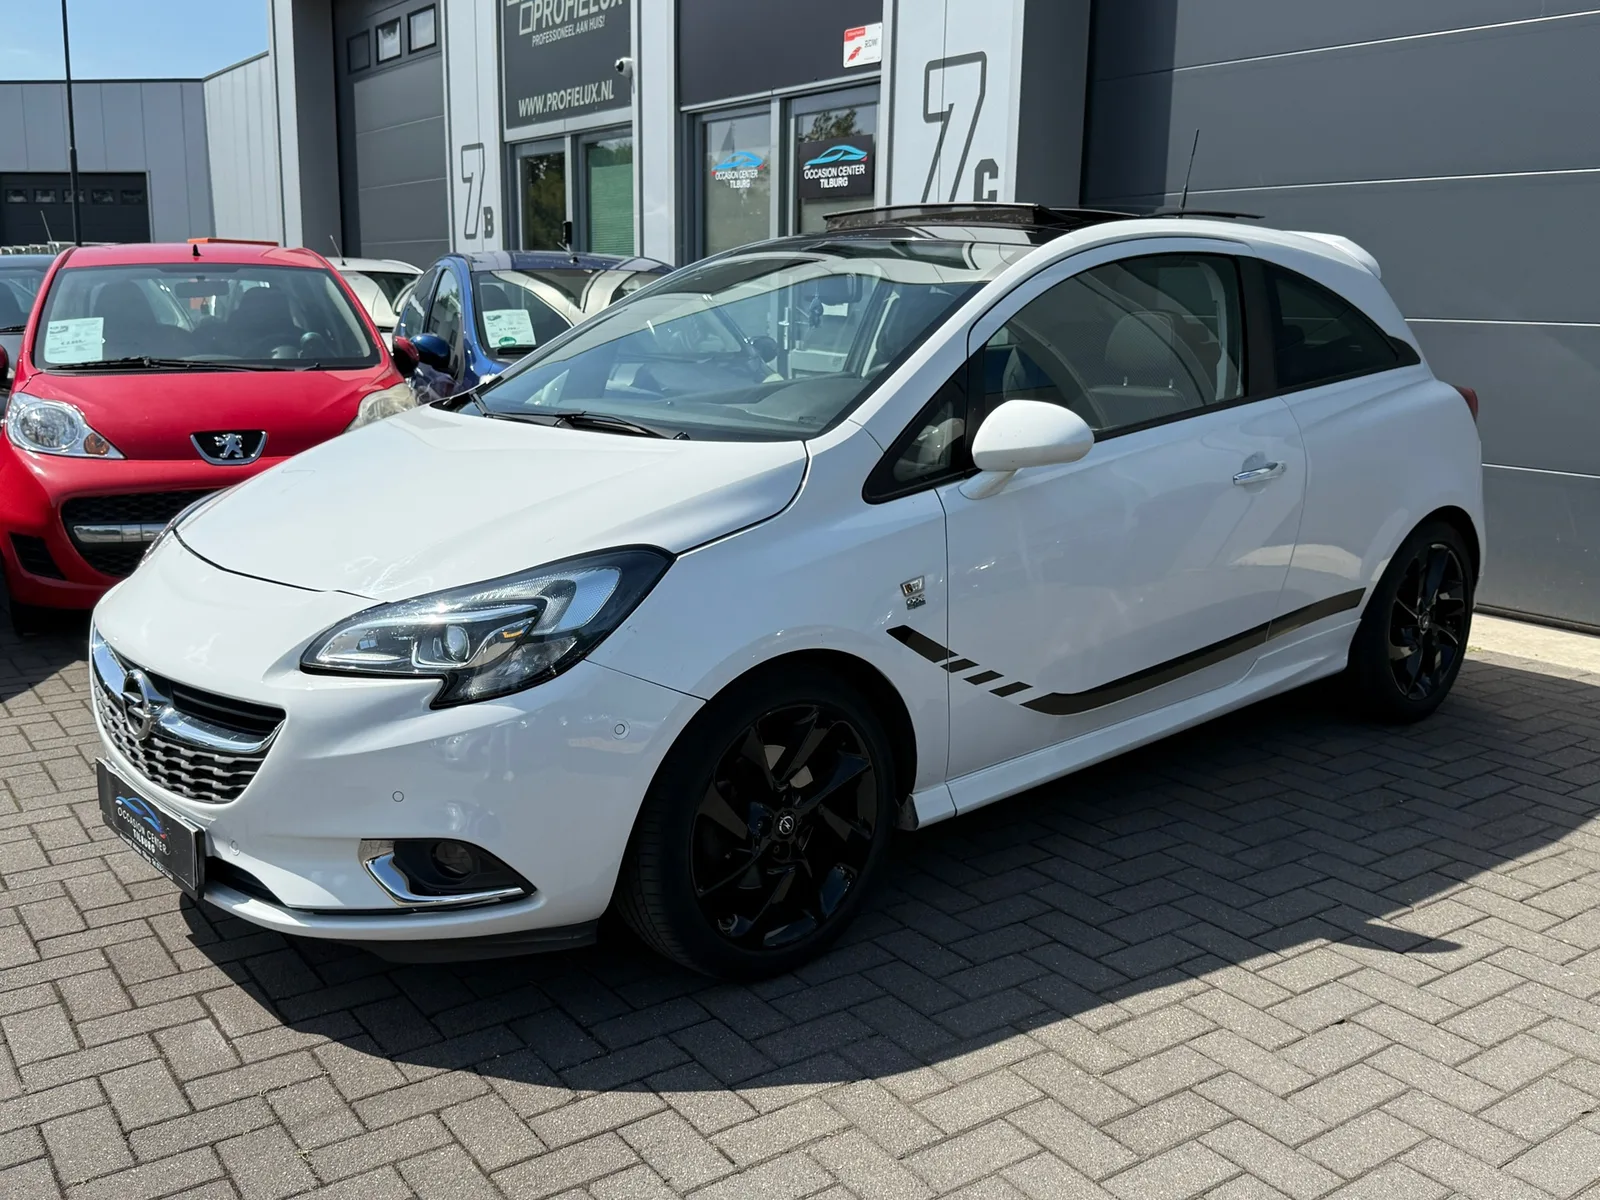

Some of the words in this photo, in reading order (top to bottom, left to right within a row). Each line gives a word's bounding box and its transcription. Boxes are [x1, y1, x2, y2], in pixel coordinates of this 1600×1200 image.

[533, 0, 623, 31] PROFIEL
[532, 24, 575, 47] PROFESSIONEEL
[576, 20, 588, 35] AAN
[589, 15, 605, 31] HUIS!
[518, 79, 614, 117] WWW.PROFIELUX.NL
[715, 170, 738, 180] OCCASION
[739, 169, 758, 179] CENTER
[804, 167, 837, 180] OCCASION
[838, 164, 865, 177] CENTER
[820, 177, 848, 188] TILBURG
[730, 179, 751, 188] TILBURG
[118, 807, 145, 836] OCCASION
